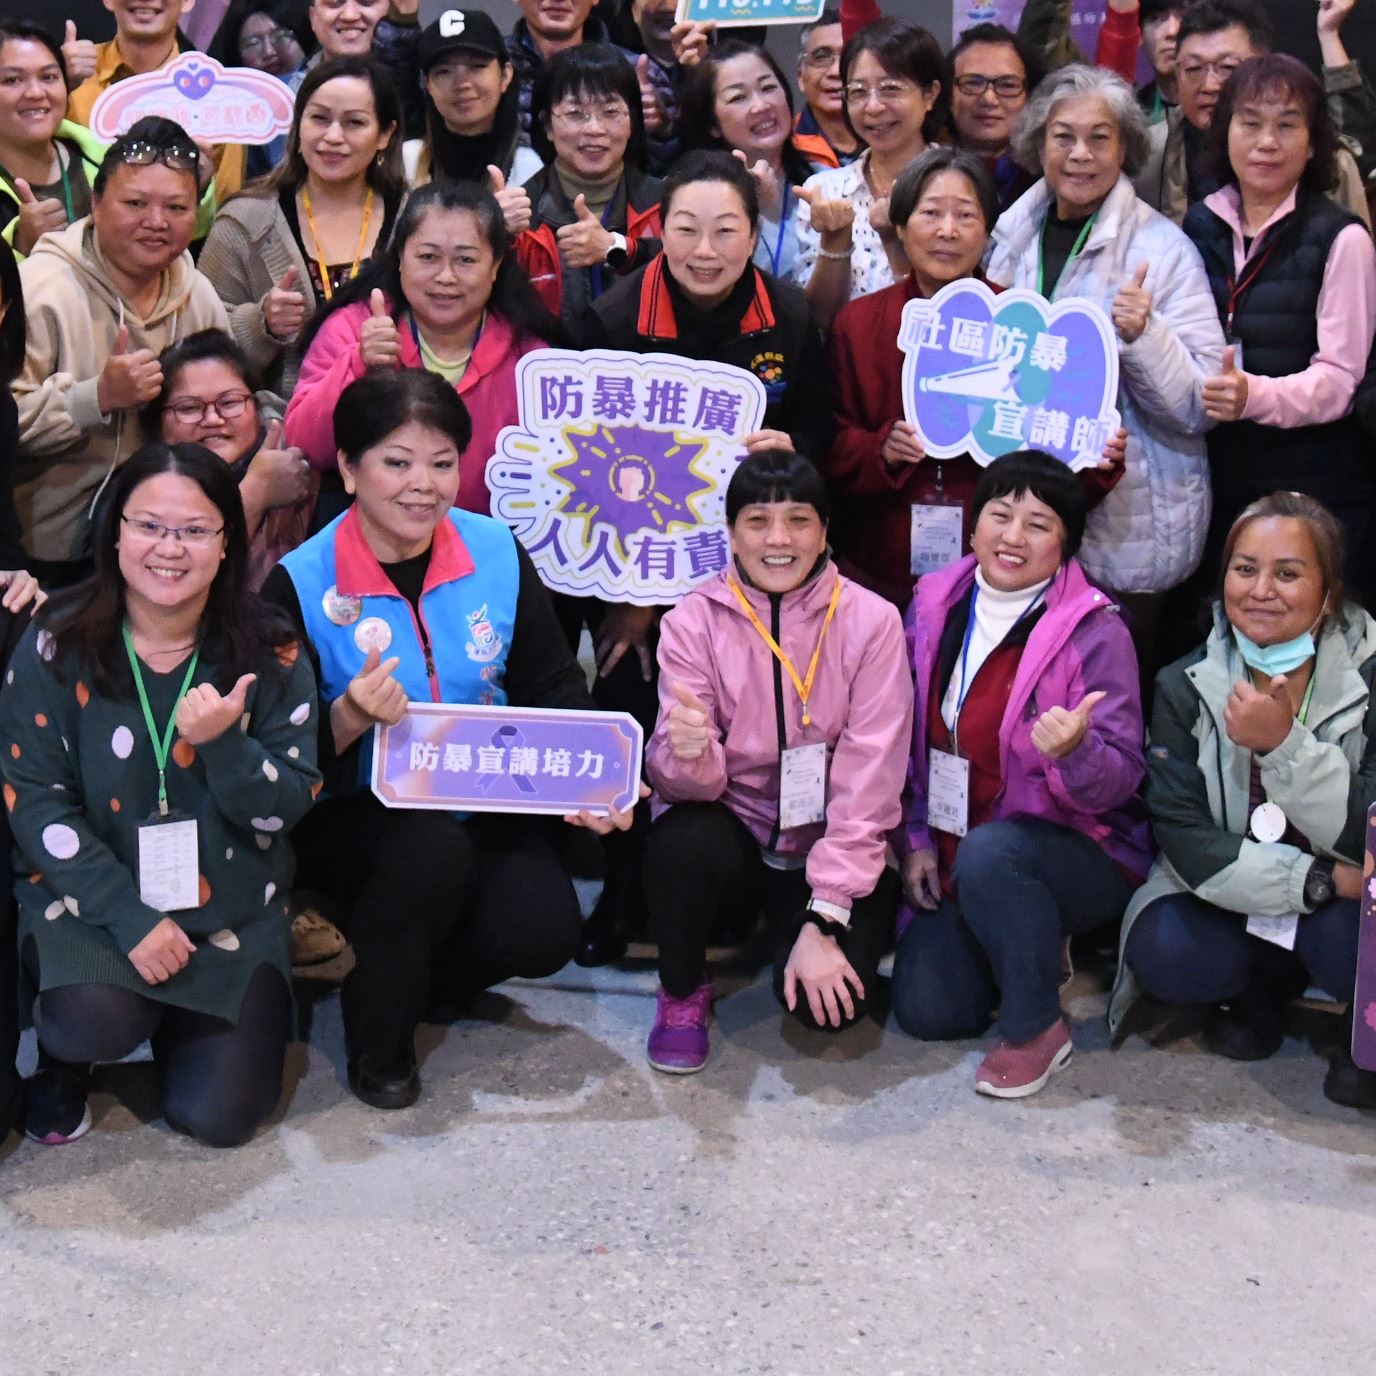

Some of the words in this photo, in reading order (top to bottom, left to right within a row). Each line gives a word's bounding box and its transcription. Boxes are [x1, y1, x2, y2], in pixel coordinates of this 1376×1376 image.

[908, 309, 1068, 372] 社區防暴
[539, 375, 743, 436] 防暴推廣
[988, 400, 1115, 459] 宣講師
[527, 517, 729, 581] 人人有責
[409, 742, 604, 779] 防暴宣講培力
